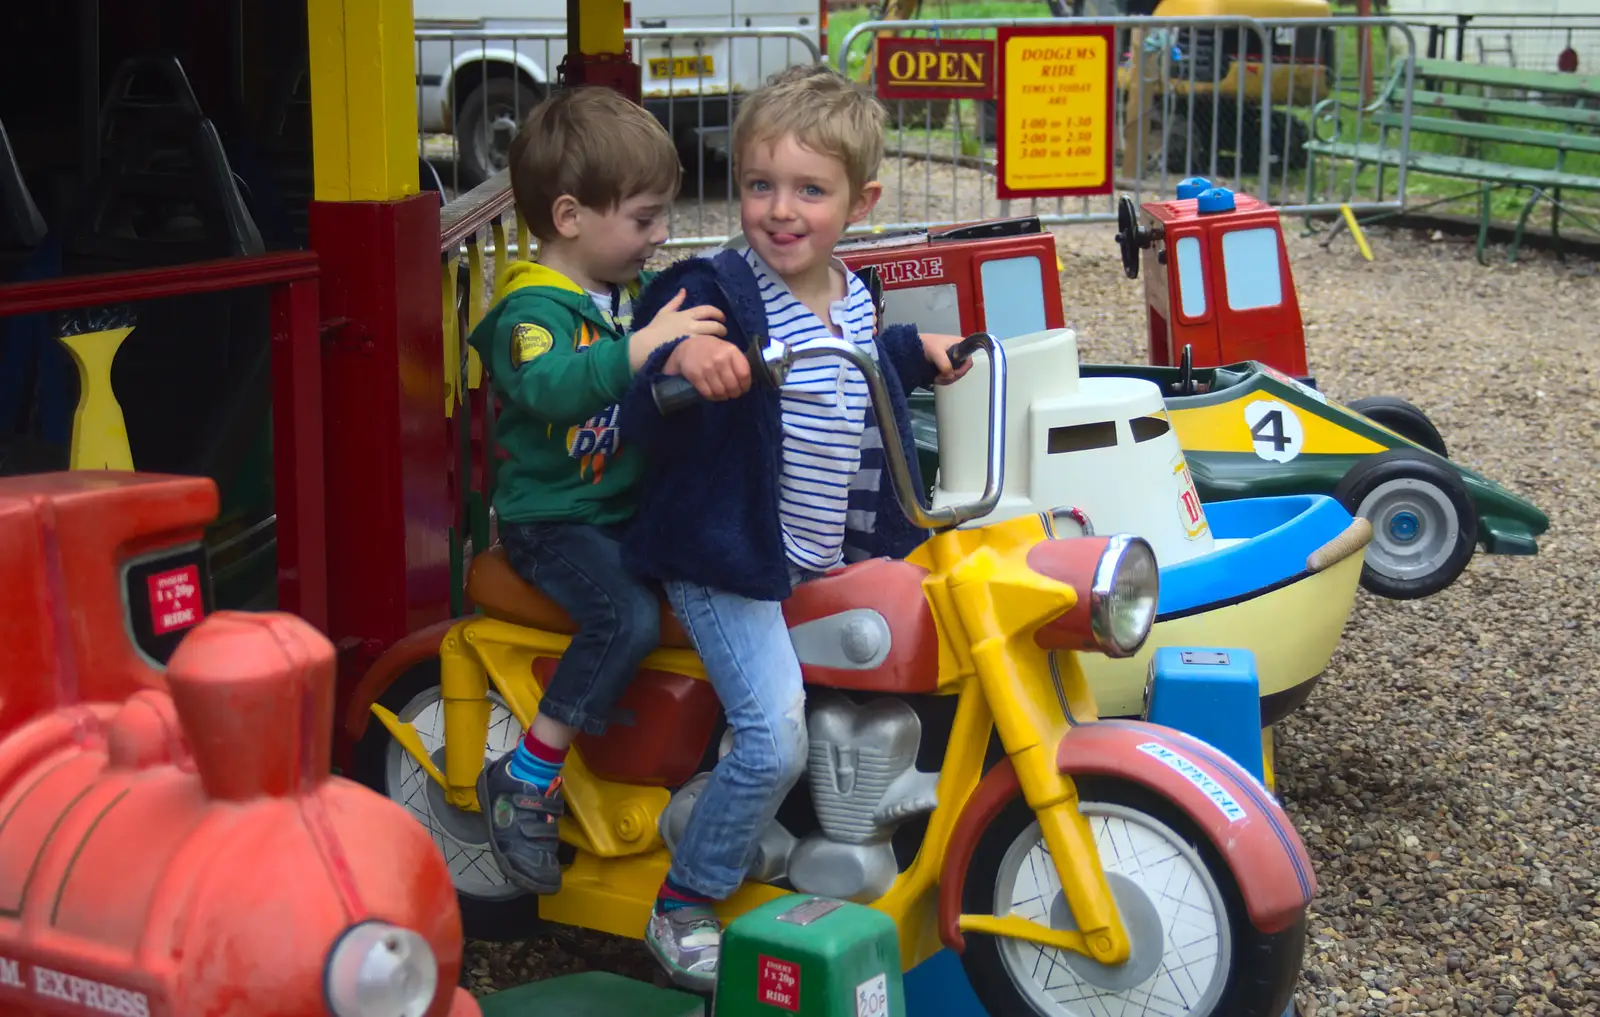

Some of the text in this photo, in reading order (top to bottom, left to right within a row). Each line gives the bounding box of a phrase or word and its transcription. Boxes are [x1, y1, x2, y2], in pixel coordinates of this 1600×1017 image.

[1022, 47, 1096, 61] DODGEMS
[889, 50, 984, 80] OPEN
[1041, 64, 1076, 77] RIDE
[1022, 83, 1091, 94] TIMES TODAY
[1251, 410, 1292, 452] 4
[163, 608, 195, 627] RIDE
[776, 983, 783, 991] A
[778, 972, 795, 987] 20p
[33, 965, 149, 1017] EXPRESS
[766, 989, 792, 1006] RIDE
